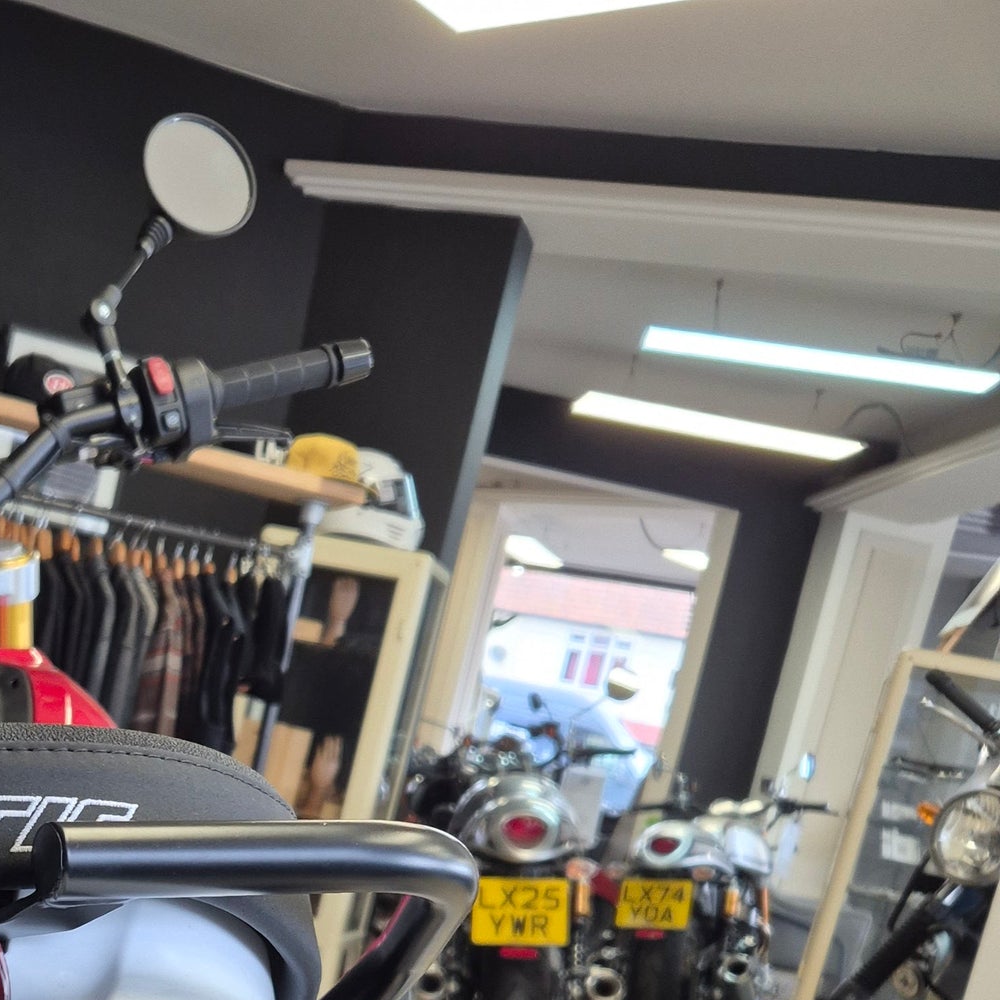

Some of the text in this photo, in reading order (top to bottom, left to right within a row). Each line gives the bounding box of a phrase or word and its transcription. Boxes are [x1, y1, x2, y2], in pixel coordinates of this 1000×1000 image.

[480, 886, 560, 910] LX25
[623, 885, 684, 904] LX74
[489, 913, 549, 938] YWR
